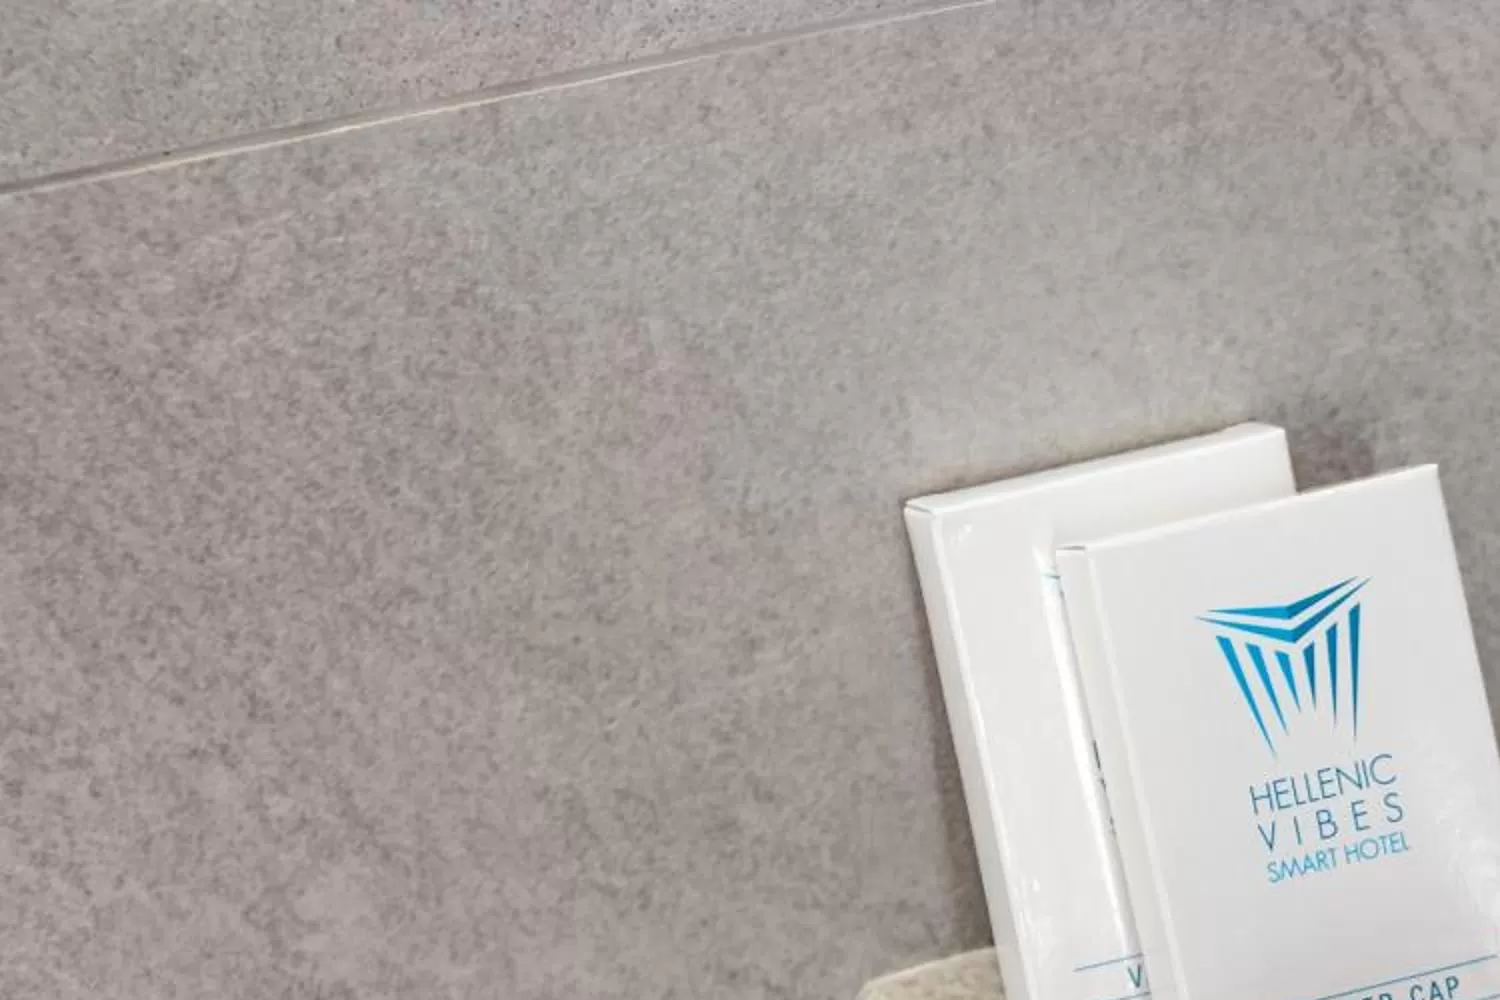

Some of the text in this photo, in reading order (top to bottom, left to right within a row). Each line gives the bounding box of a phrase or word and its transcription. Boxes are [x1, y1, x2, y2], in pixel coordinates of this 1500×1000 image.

[1249, 753, 1397, 816] HELLENIC
[1257, 791, 1404, 852] VIBES
[1267, 831, 1412, 883] SMART HOTEL
